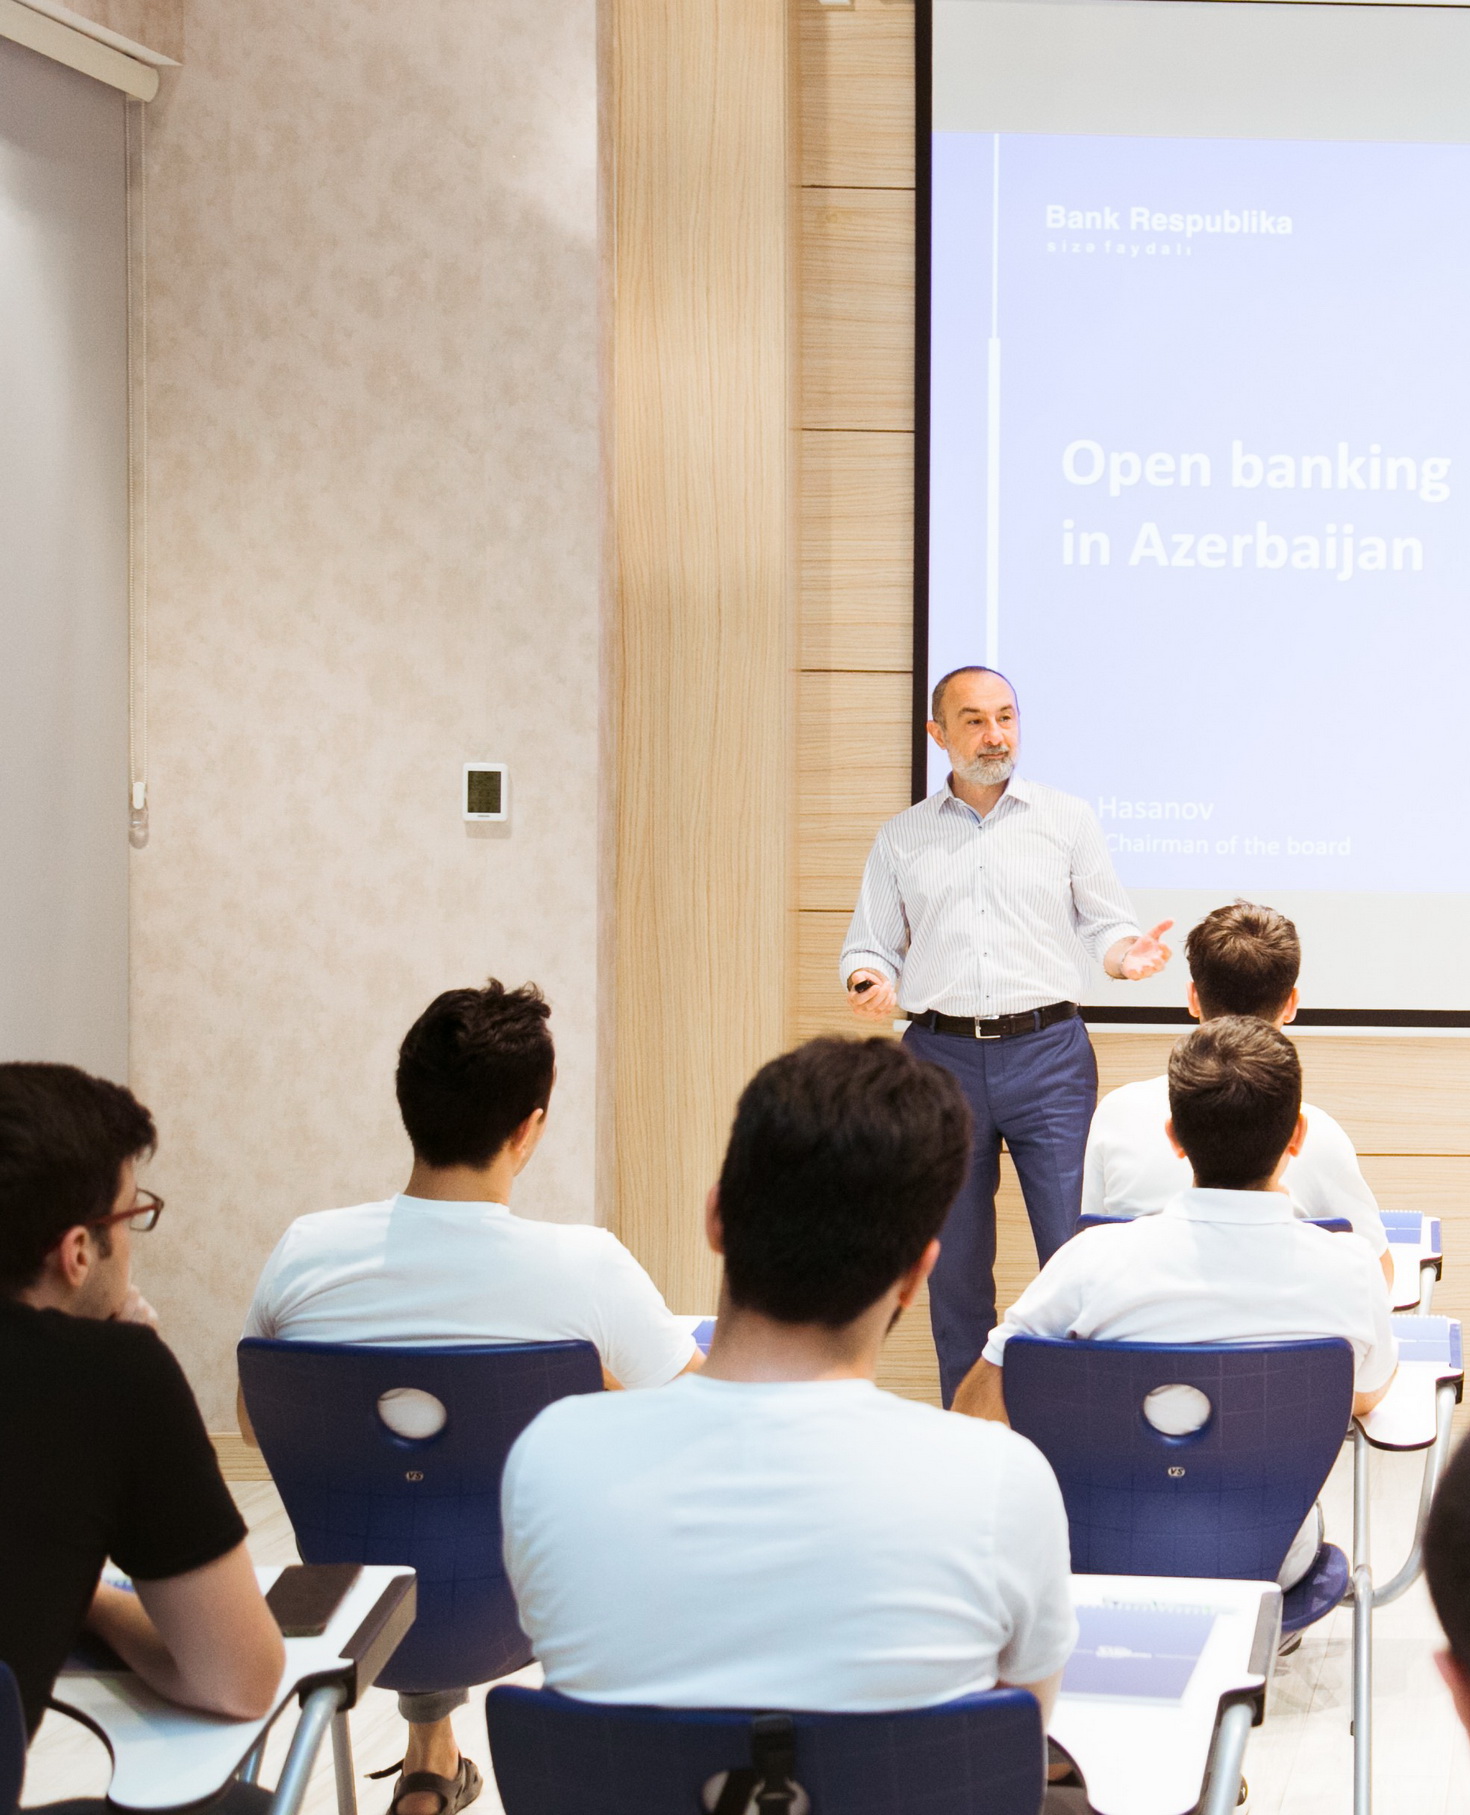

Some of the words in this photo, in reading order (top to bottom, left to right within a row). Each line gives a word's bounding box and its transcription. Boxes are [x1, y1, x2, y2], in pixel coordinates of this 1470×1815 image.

[1045, 204, 1120, 231] Bank
[1130, 206, 1293, 238] Respublika
[1061, 439, 1212, 497] Open
[1231, 439, 1452, 503] banking
[1062, 519, 1111, 567] in
[1128, 520, 1424, 582] Azerbaijan
[1097, 795, 1215, 821] Hasanov
[1105, 833, 1209, 854] Chairman
[1215, 834, 1238, 855] of
[1244, 835, 1280, 855] the
[1286, 835, 1351, 856] board
